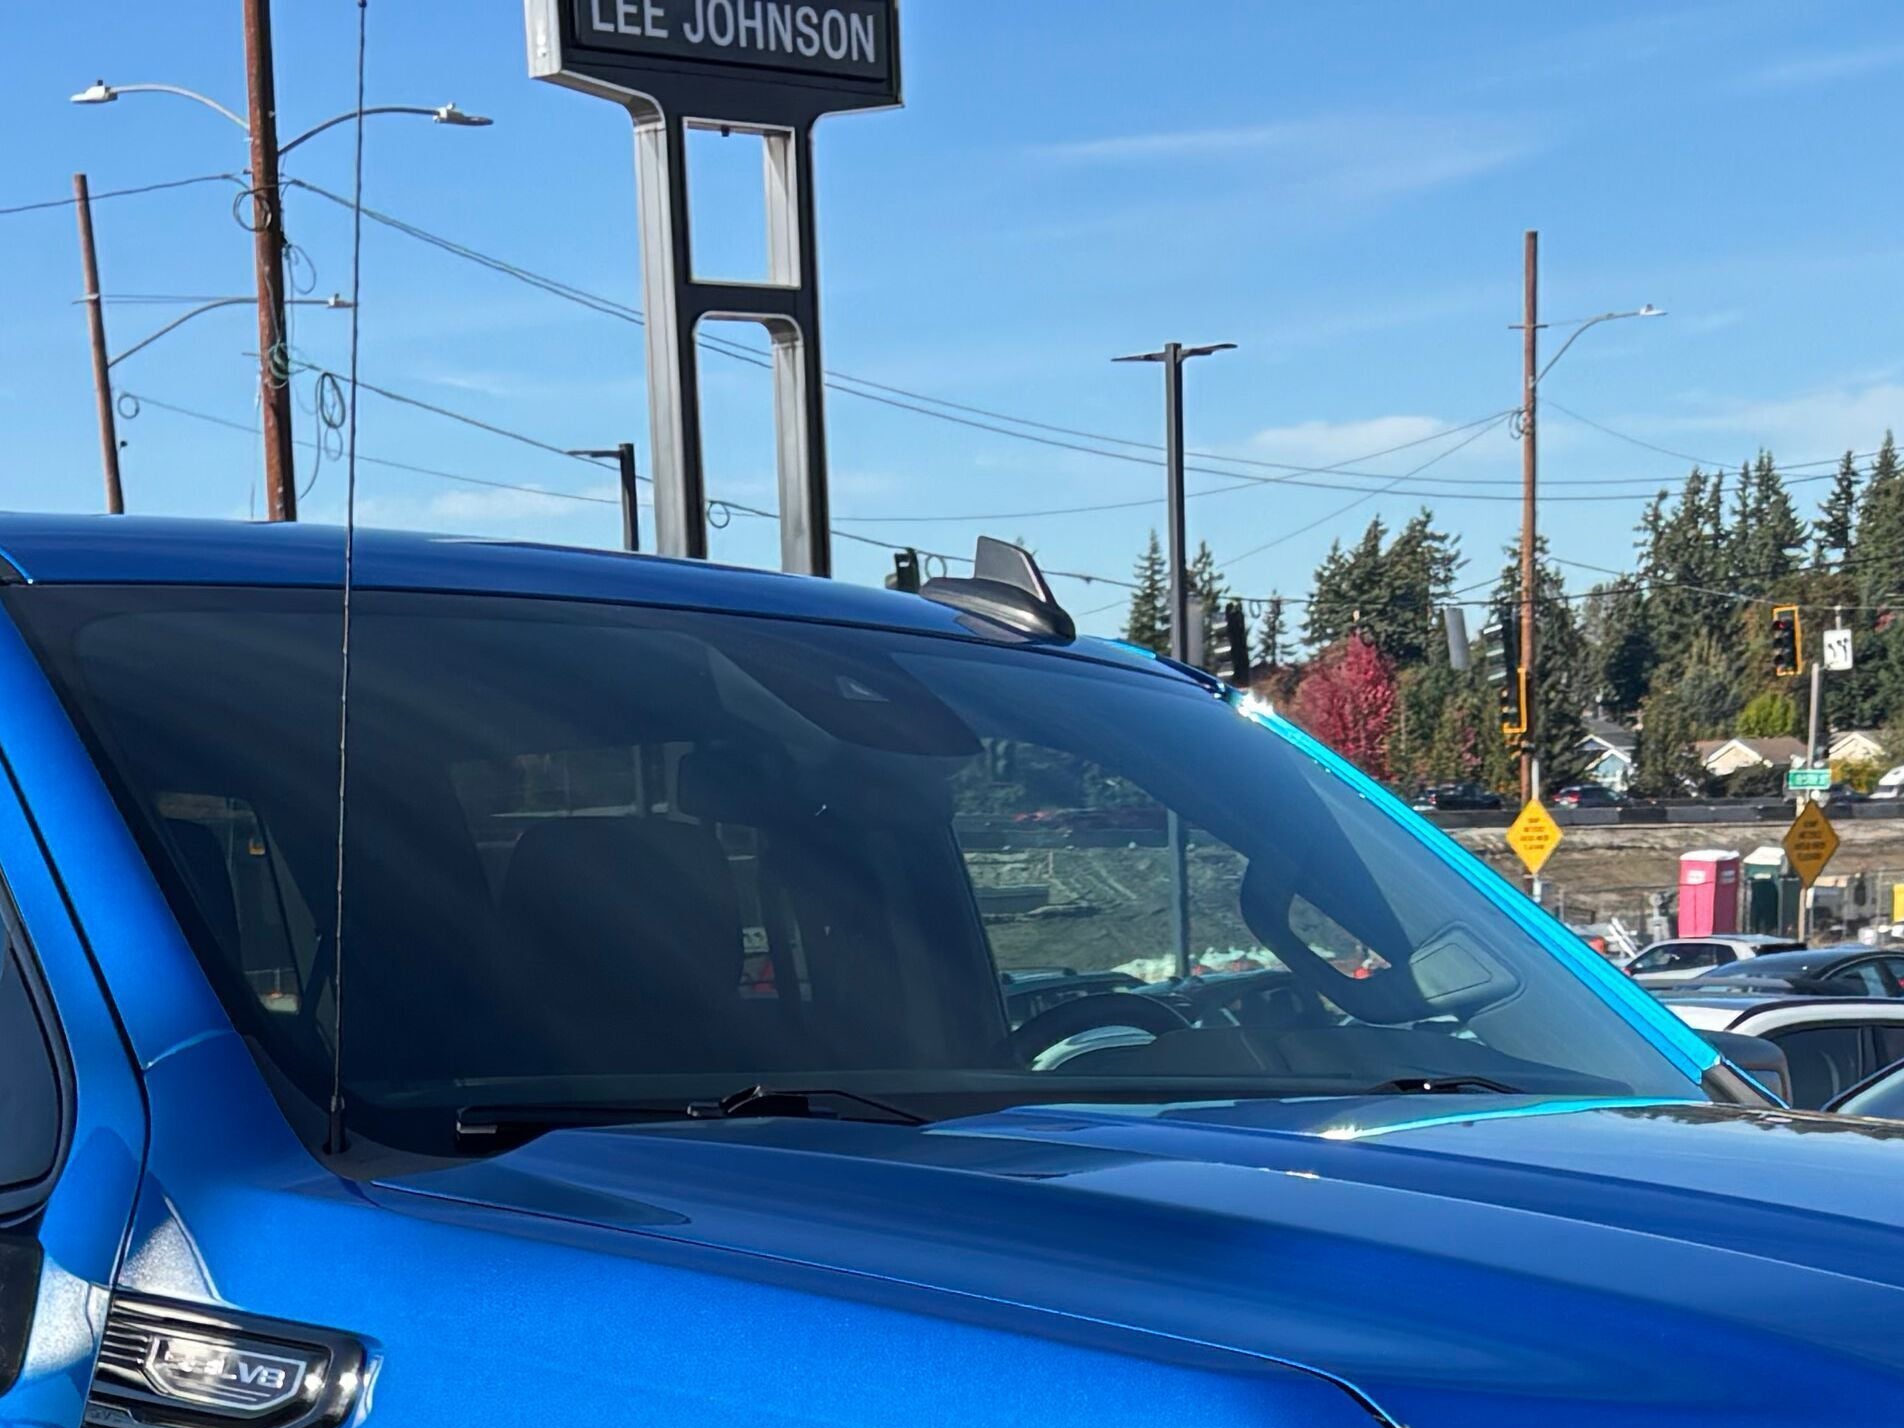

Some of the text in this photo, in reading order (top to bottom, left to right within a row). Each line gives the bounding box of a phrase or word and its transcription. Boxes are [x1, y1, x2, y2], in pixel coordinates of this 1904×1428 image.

[592, 0, 876, 63] LEE JOHNSON
[238, 1360, 287, 1390] V8
